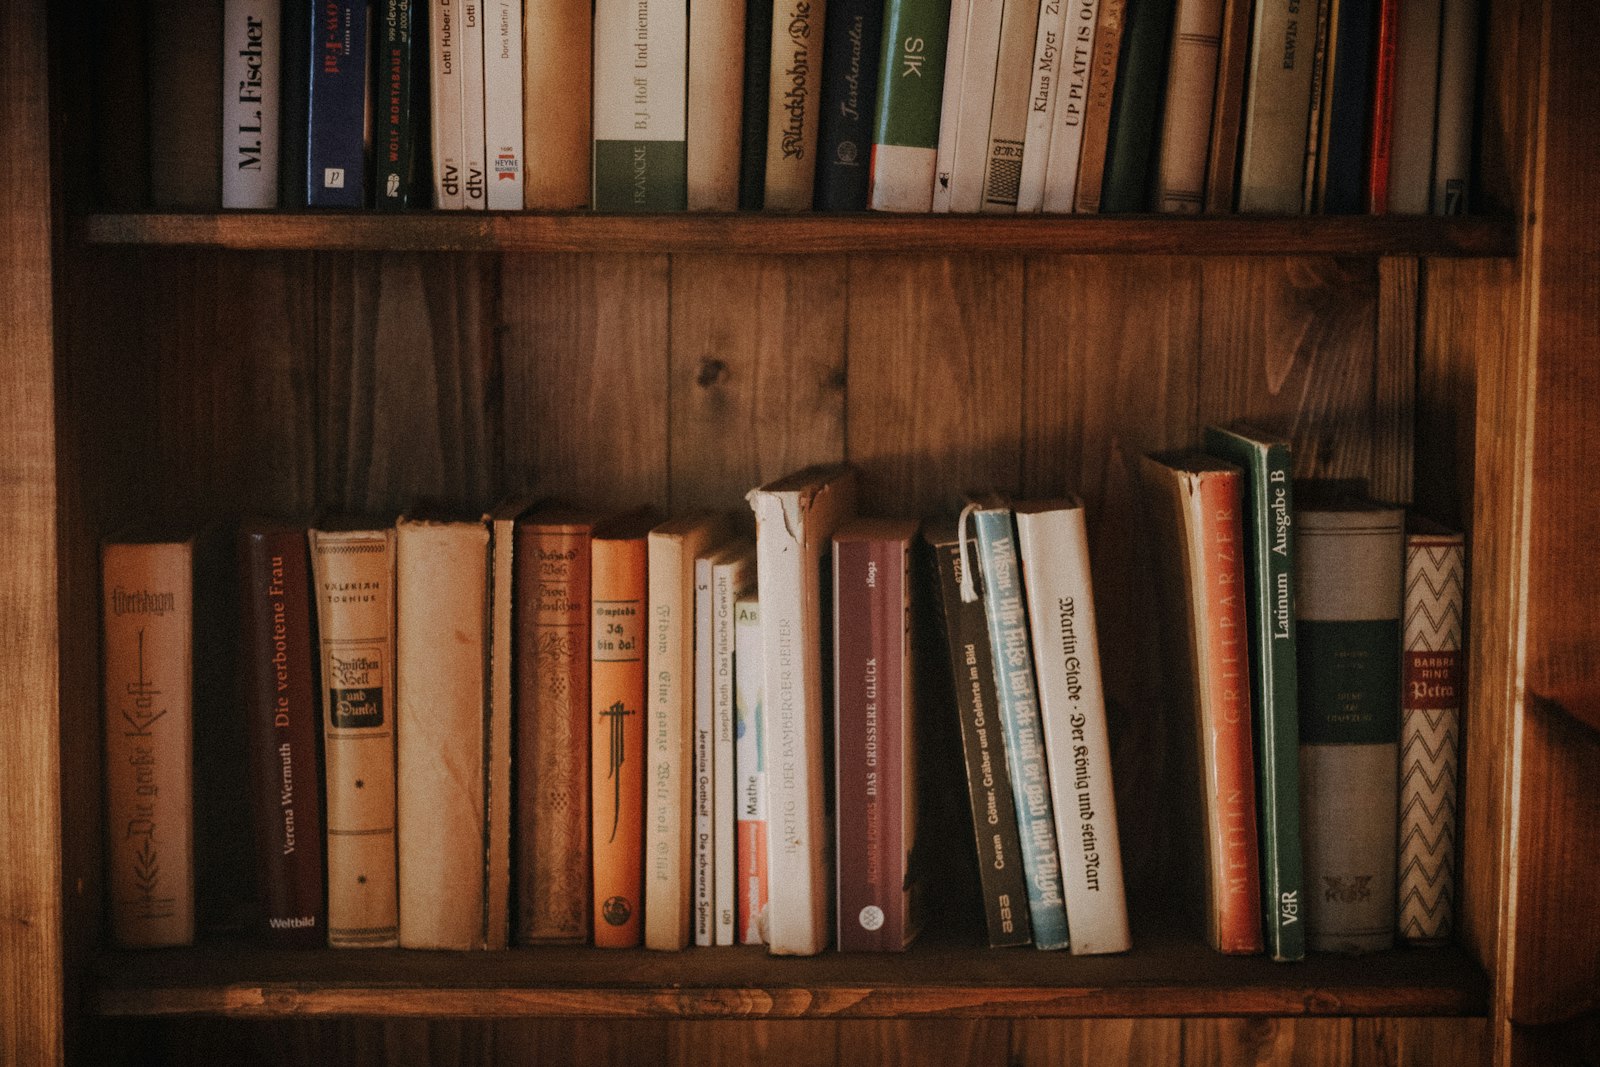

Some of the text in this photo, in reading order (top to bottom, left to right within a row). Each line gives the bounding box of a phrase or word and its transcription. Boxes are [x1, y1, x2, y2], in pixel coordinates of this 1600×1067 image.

[442, 10, 451, 47] Huber:
[466, 4, 475, 28] Lotti
[501, 38, 509, 59] Doris
[1077, 26, 1090, 44] IS
[1282, 18, 1298, 70] ERWIN
[443, 51, 451, 75] Lotti
[634, 44, 648, 68] Und
[1040, 32, 1058, 72] Meyer
[1070, 46, 1088, 100] PLATT
[1097, 42, 1113, 108] FRANCIS
[239, 16, 263, 170] M. L. Fischer
[634, 76, 648, 104] Hoff
[1034, 77, 1049, 112] Klaus
[1066, 104, 1080, 127] UP
[389, 131, 399, 162] WOLF
[442, 165, 458, 196] dtv
[466, 168, 482, 198] dtv
[634, 145, 646, 205] FRANCKE
[992, 537, 1012, 588] Wilson
[1271, 470, 1291, 640] Latinum Ausgabe B
[324, 582, 380, 592] VALERIAN
[866, 561, 878, 588] 18092
[607, 624, 624, 636] Ich
[1216, 508, 1240, 724] GRILLPARZER
[270, 554, 289, 730] Die verbotene Frau
[598, 636, 635, 650] bin da!
[778, 618, 792, 666] REITER
[964, 644, 976, 665] Bild
[331, 656, 379, 672] Zwischen
[718, 576, 732, 744] Joseph Roth Das falsche Gewicht
[970, 666, 978, 680] im
[658, 670, 671, 704] Eine
[864, 658, 876, 699] GLÜCK
[1410, 681, 1454, 700] Petra
[337, 701, 378, 715] Dunkel
[346, 690, 366, 701] und
[971, 682, 985, 727] Gelehrte
[780, 670, 794, 757] BAMBERGER
[656, 712, 669, 752] ganze
[865, 702, 877, 766] GRÖSSERE
[976, 728, 988, 748] und
[1018, 728, 1041, 759] und
[1059, 597, 1100, 892] Martin Stade Der König und sein Narr
[657, 762, 670, 799] Welt
[782, 762, 794, 789] DER
[866, 772, 877, 796] DAS
[980, 750, 993, 787] Gräber
[1025, 762, 1042, 781] er
[280, 742, 294, 856] Verena Wermuth
[746, 776, 758, 816] Mathe
[1025, 784, 1048, 816] gab
[657, 806, 669, 833] voll
[698, 730, 709, 935] Jeremias Gotthelf Die schwarze Spinne
[1032, 819, 1054, 850] mir
[992, 834, 1004, 870] Ceram
[270, 917, 315, 928] Weltbild
[1281, 890, 1298, 926] V&R
